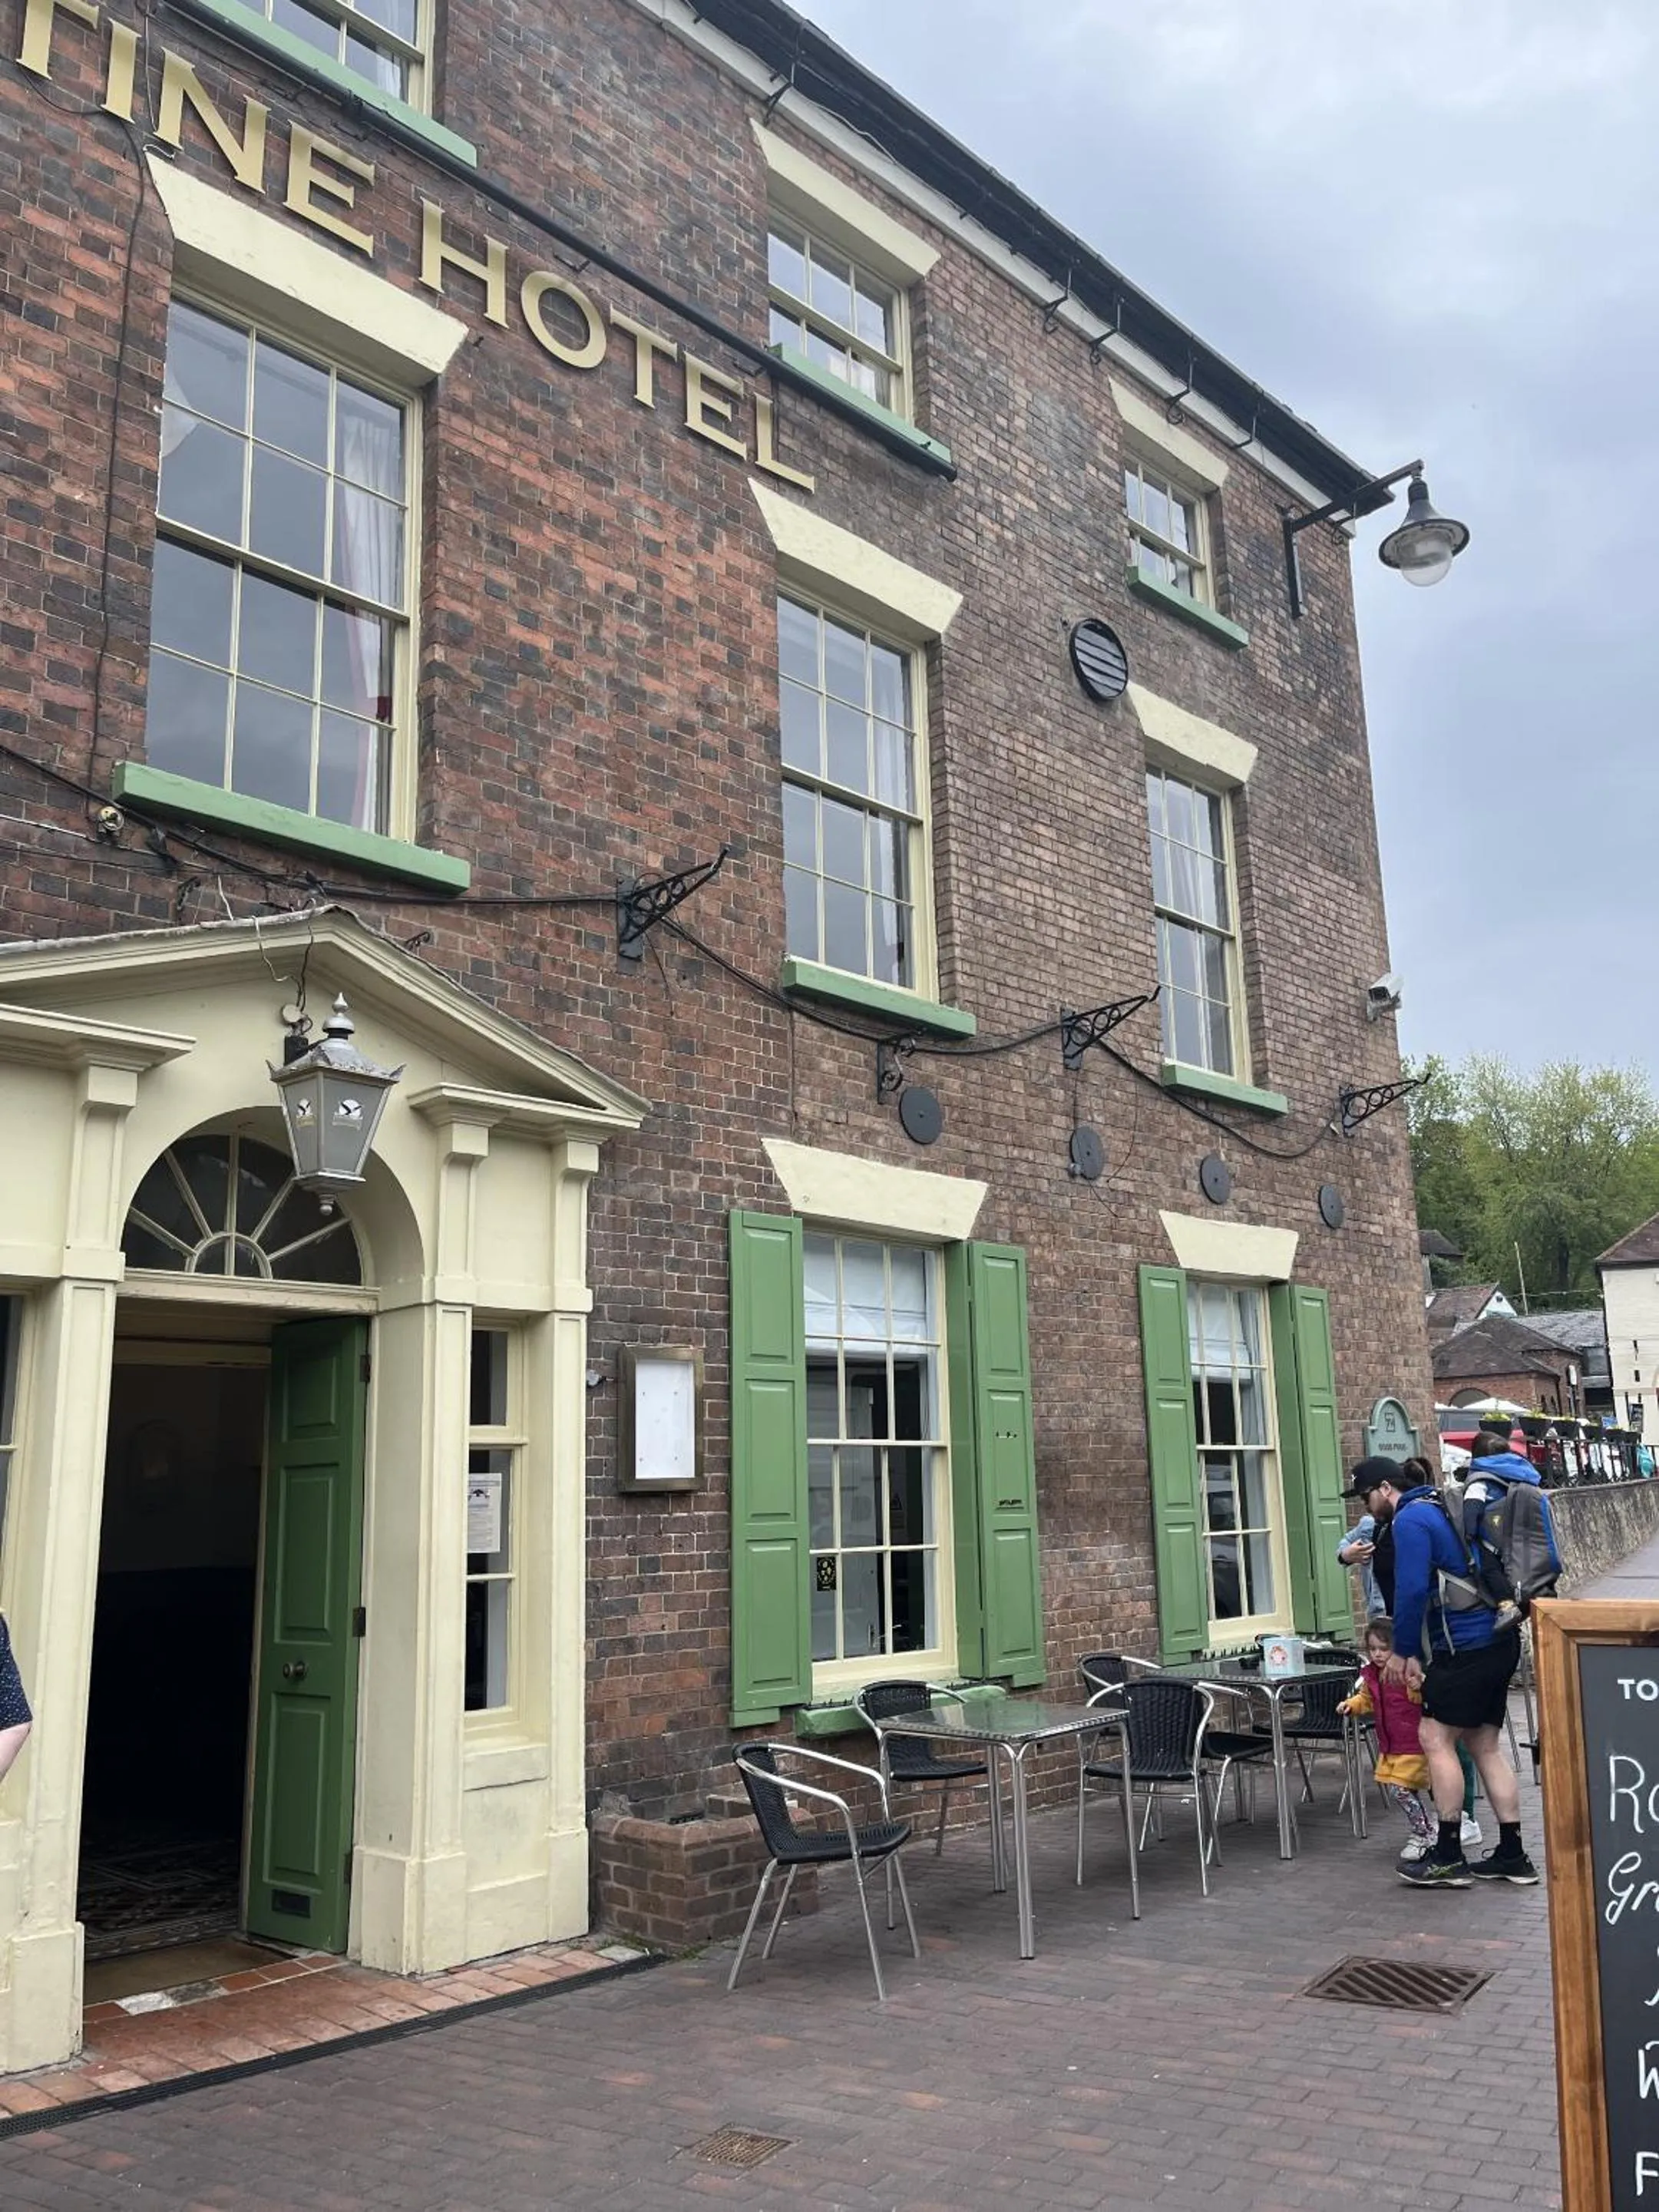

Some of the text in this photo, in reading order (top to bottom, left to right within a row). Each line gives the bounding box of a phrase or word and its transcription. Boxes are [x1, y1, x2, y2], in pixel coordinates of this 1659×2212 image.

[420, 197, 815, 492] HOTEL
[1618, 1678, 1659, 1701] TO
[1605, 1851, 1659, 1925] Gr
